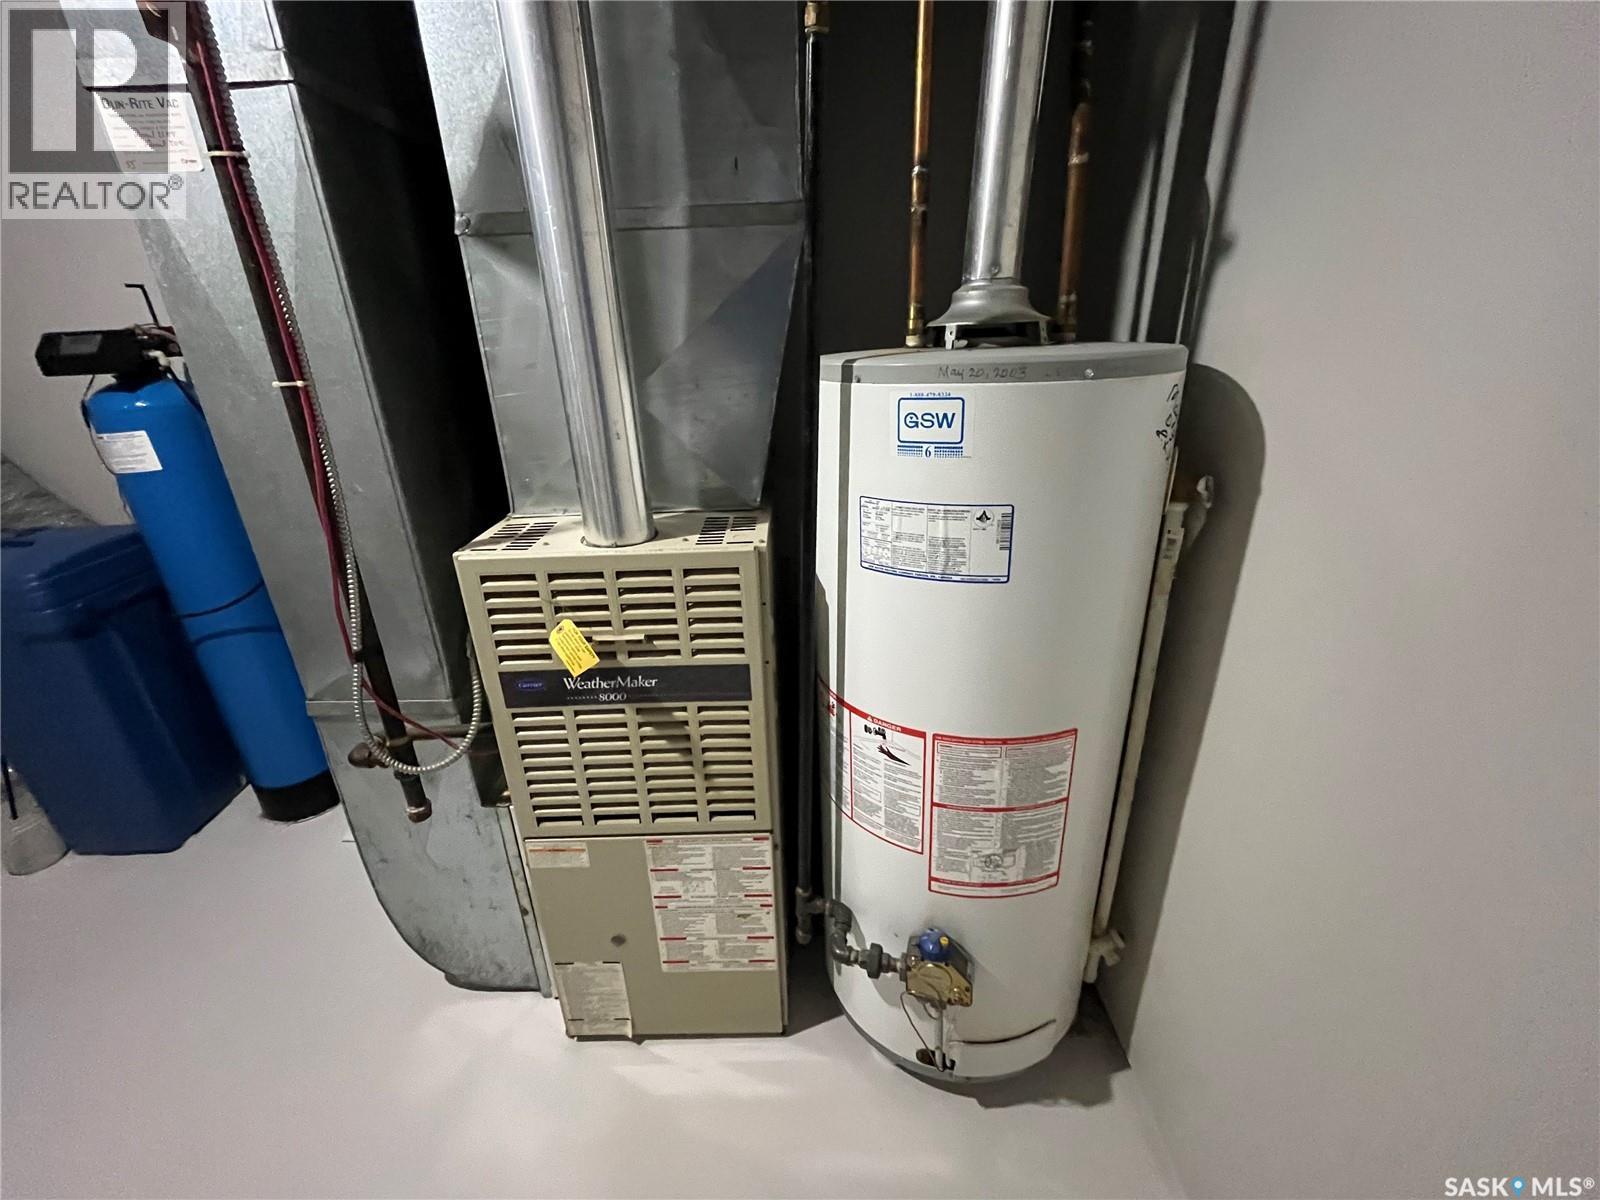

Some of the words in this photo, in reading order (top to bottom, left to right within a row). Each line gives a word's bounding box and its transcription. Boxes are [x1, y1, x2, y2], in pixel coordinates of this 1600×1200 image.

[938, 365, 965, 381] May
[993, 366, 1028, 379] 2003
[904, 412, 956, 429] GSW
[924, 446, 932, 458] 6
[563, 674, 658, 690] WeatherMaker
[598, 692, 627, 702] 8000
[873, 718, 902, 732] DANGER
